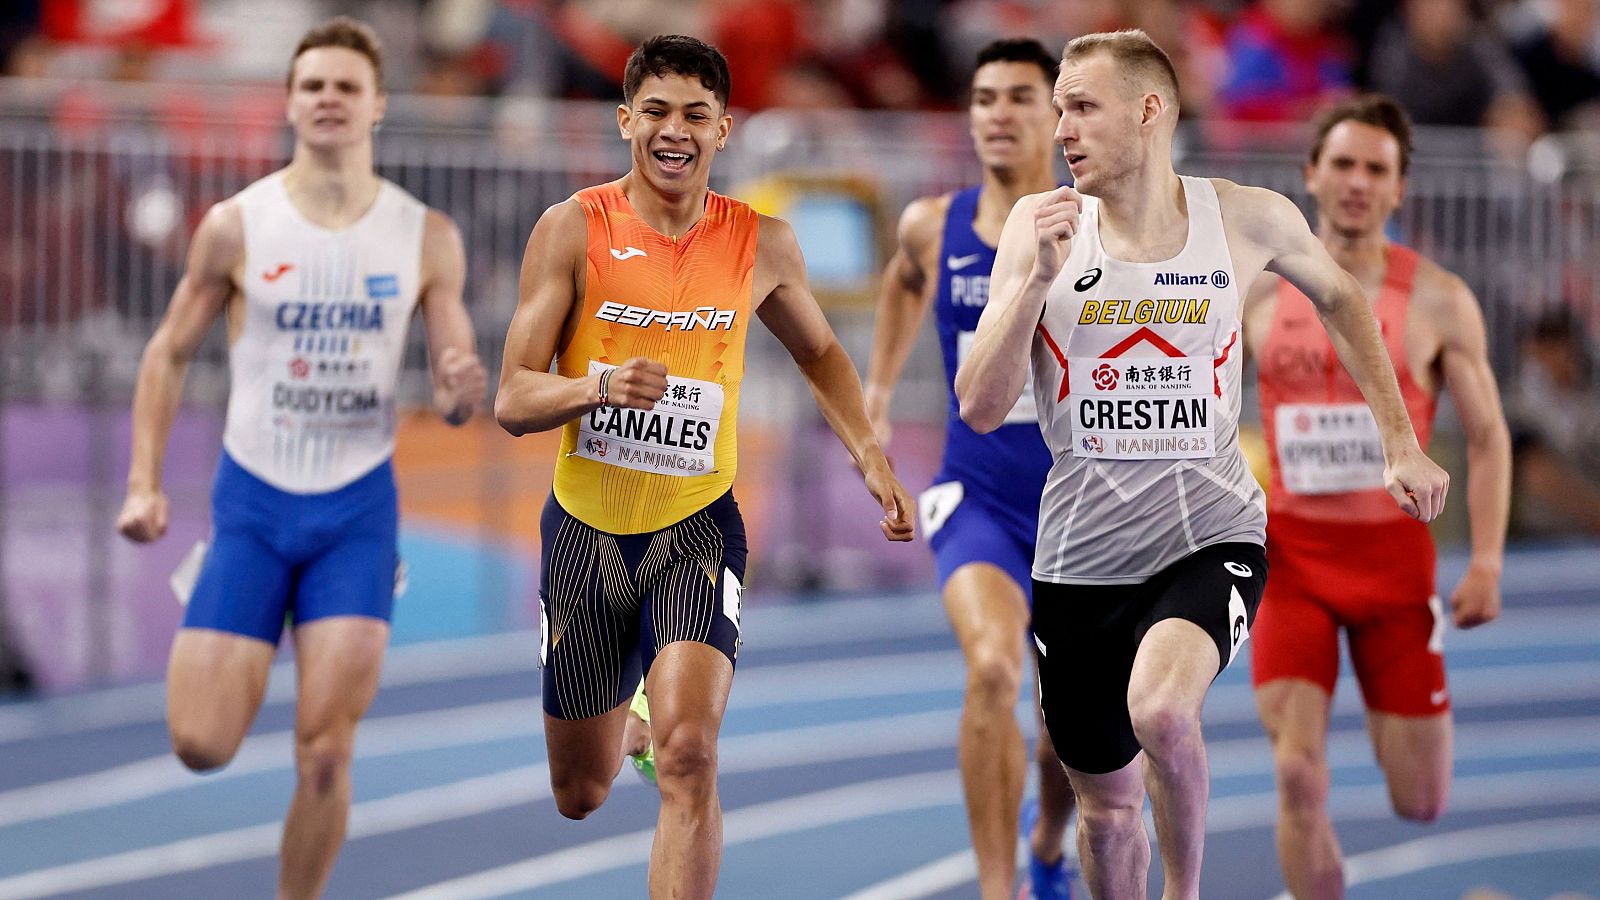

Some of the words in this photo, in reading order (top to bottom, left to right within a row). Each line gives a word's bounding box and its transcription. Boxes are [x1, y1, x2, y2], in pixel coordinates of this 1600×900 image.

[951, 275, 990, 306] PUE
[1154, 273, 1208, 285] Allianz
[276, 302, 384, 332] CZECHIA
[595, 300, 737, 332] ESPAÑA
[1077, 299, 1211, 325] BELGIUM
[1125, 365, 1192, 382] 南京银行
[273, 382, 380, 414] DUDYCHA
[671, 401, 700, 411] NANJING
[589, 404, 712, 451] CANALES
[1079, 398, 1208, 431] CRESTAN
[617, 446, 687, 470] NANJING
[687, 458, 705, 472] 25
[1115, 437, 1189, 455] NANJING
[1191, 437, 1208, 451] 25
